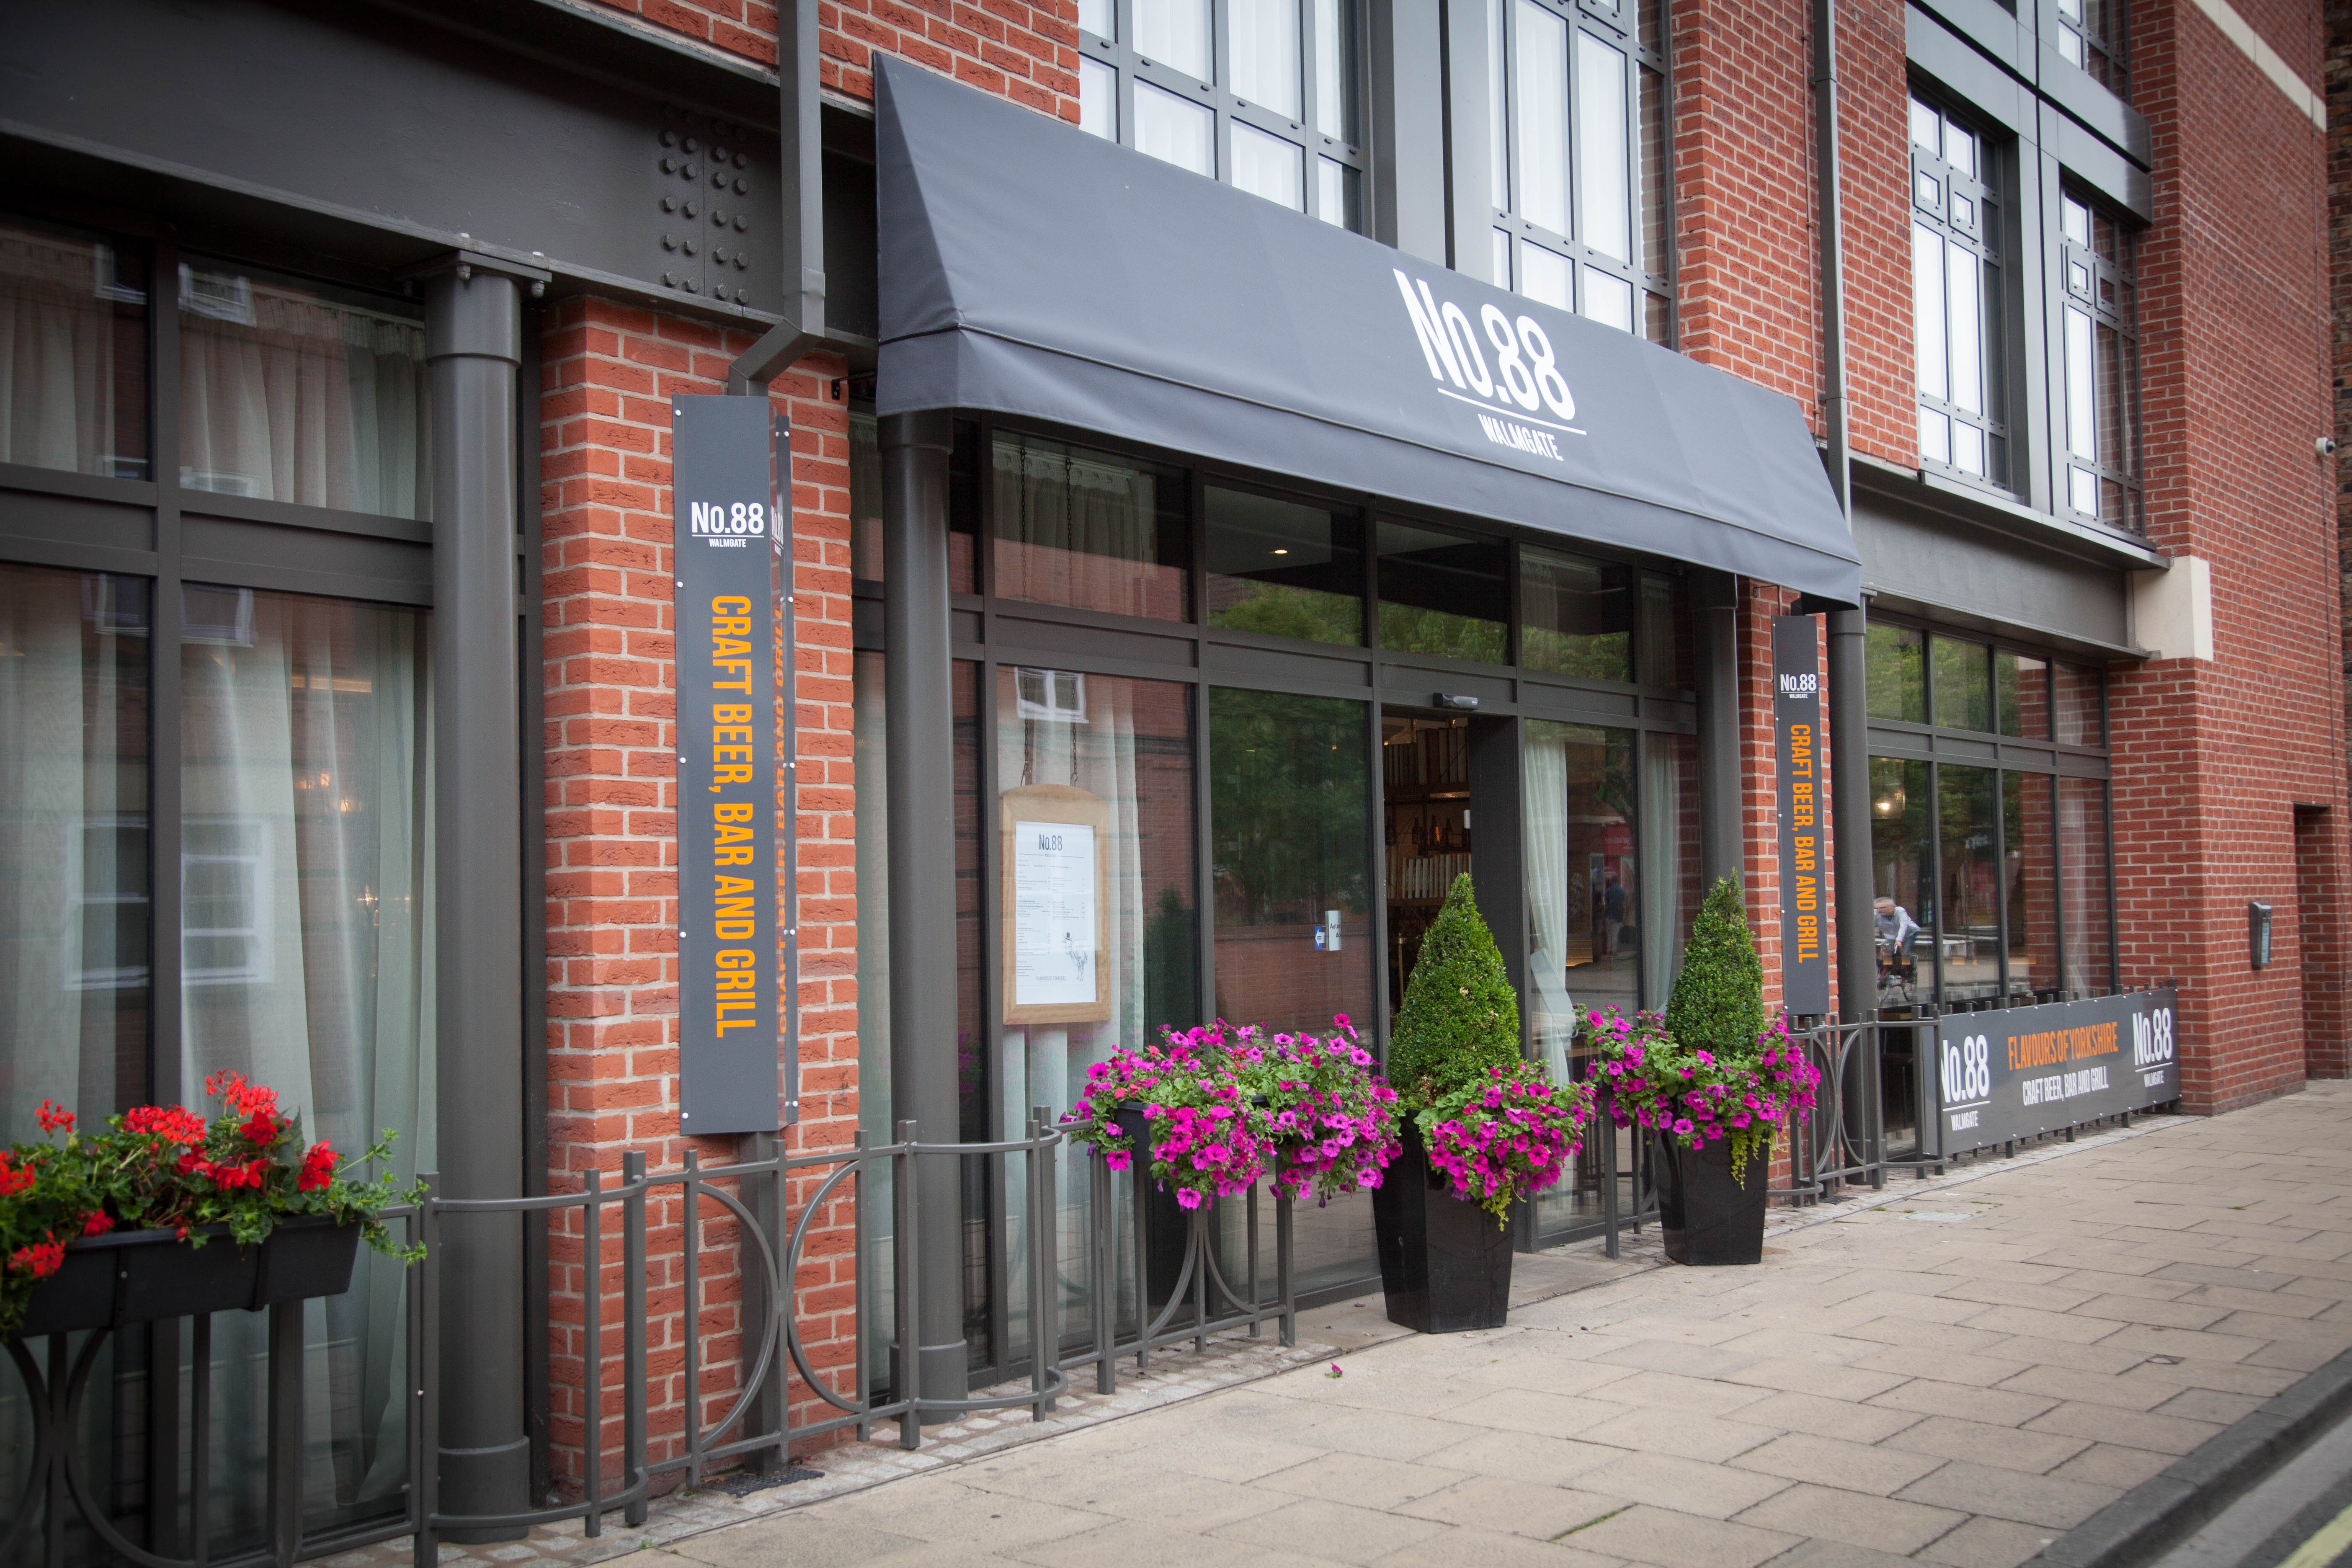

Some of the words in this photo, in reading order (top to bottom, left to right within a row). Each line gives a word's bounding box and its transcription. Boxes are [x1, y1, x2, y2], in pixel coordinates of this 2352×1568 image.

[1393, 268, 1575, 420] No.88
[1478, 413, 1564, 461] WALMGATE
[691, 502, 764, 534] No.88
[709, 539, 746, 547] WALMGATE
[712, 596, 751, 694] CRAFT
[775, 604, 784, 687] GRILL
[1780, 673, 1816, 691] No.88
[709, 704, 753, 792] BEER,
[776, 696, 784, 760] AND
[1791, 725, 1812, 778] CRAFT
[1792, 783, 1813, 831] BEER,
[714, 803, 753, 866] BAR
[1039, 834, 1063, 851] No.88
[1795, 837, 1815, 870] BAR
[715, 875, 754, 939] AND
[1796, 875, 1816, 910] AND
[1798, 916, 1818, 963] GRILL
[715, 949, 756, 1037] GRILL
[2008, 1035, 2057, 1070] FLAVOURS
[2057, 1029, 2069, 1061] OF
[2068, 1022, 2119, 1060] YORKSHIRE
[2132, 1008, 2172, 1065] No.88
[2022, 1078, 2043, 1106] CRAFT
[2044, 1075, 2064, 1101] BEER,
[2064, 1073, 2077, 1097] BAR
[2078, 1069, 2091, 1094] AND
[2090, 1066, 2109, 1091] GRILL
[2144, 1070, 2164, 1087] WALMGATE
[1951, 1110, 1978, 1131] WALMGATE
